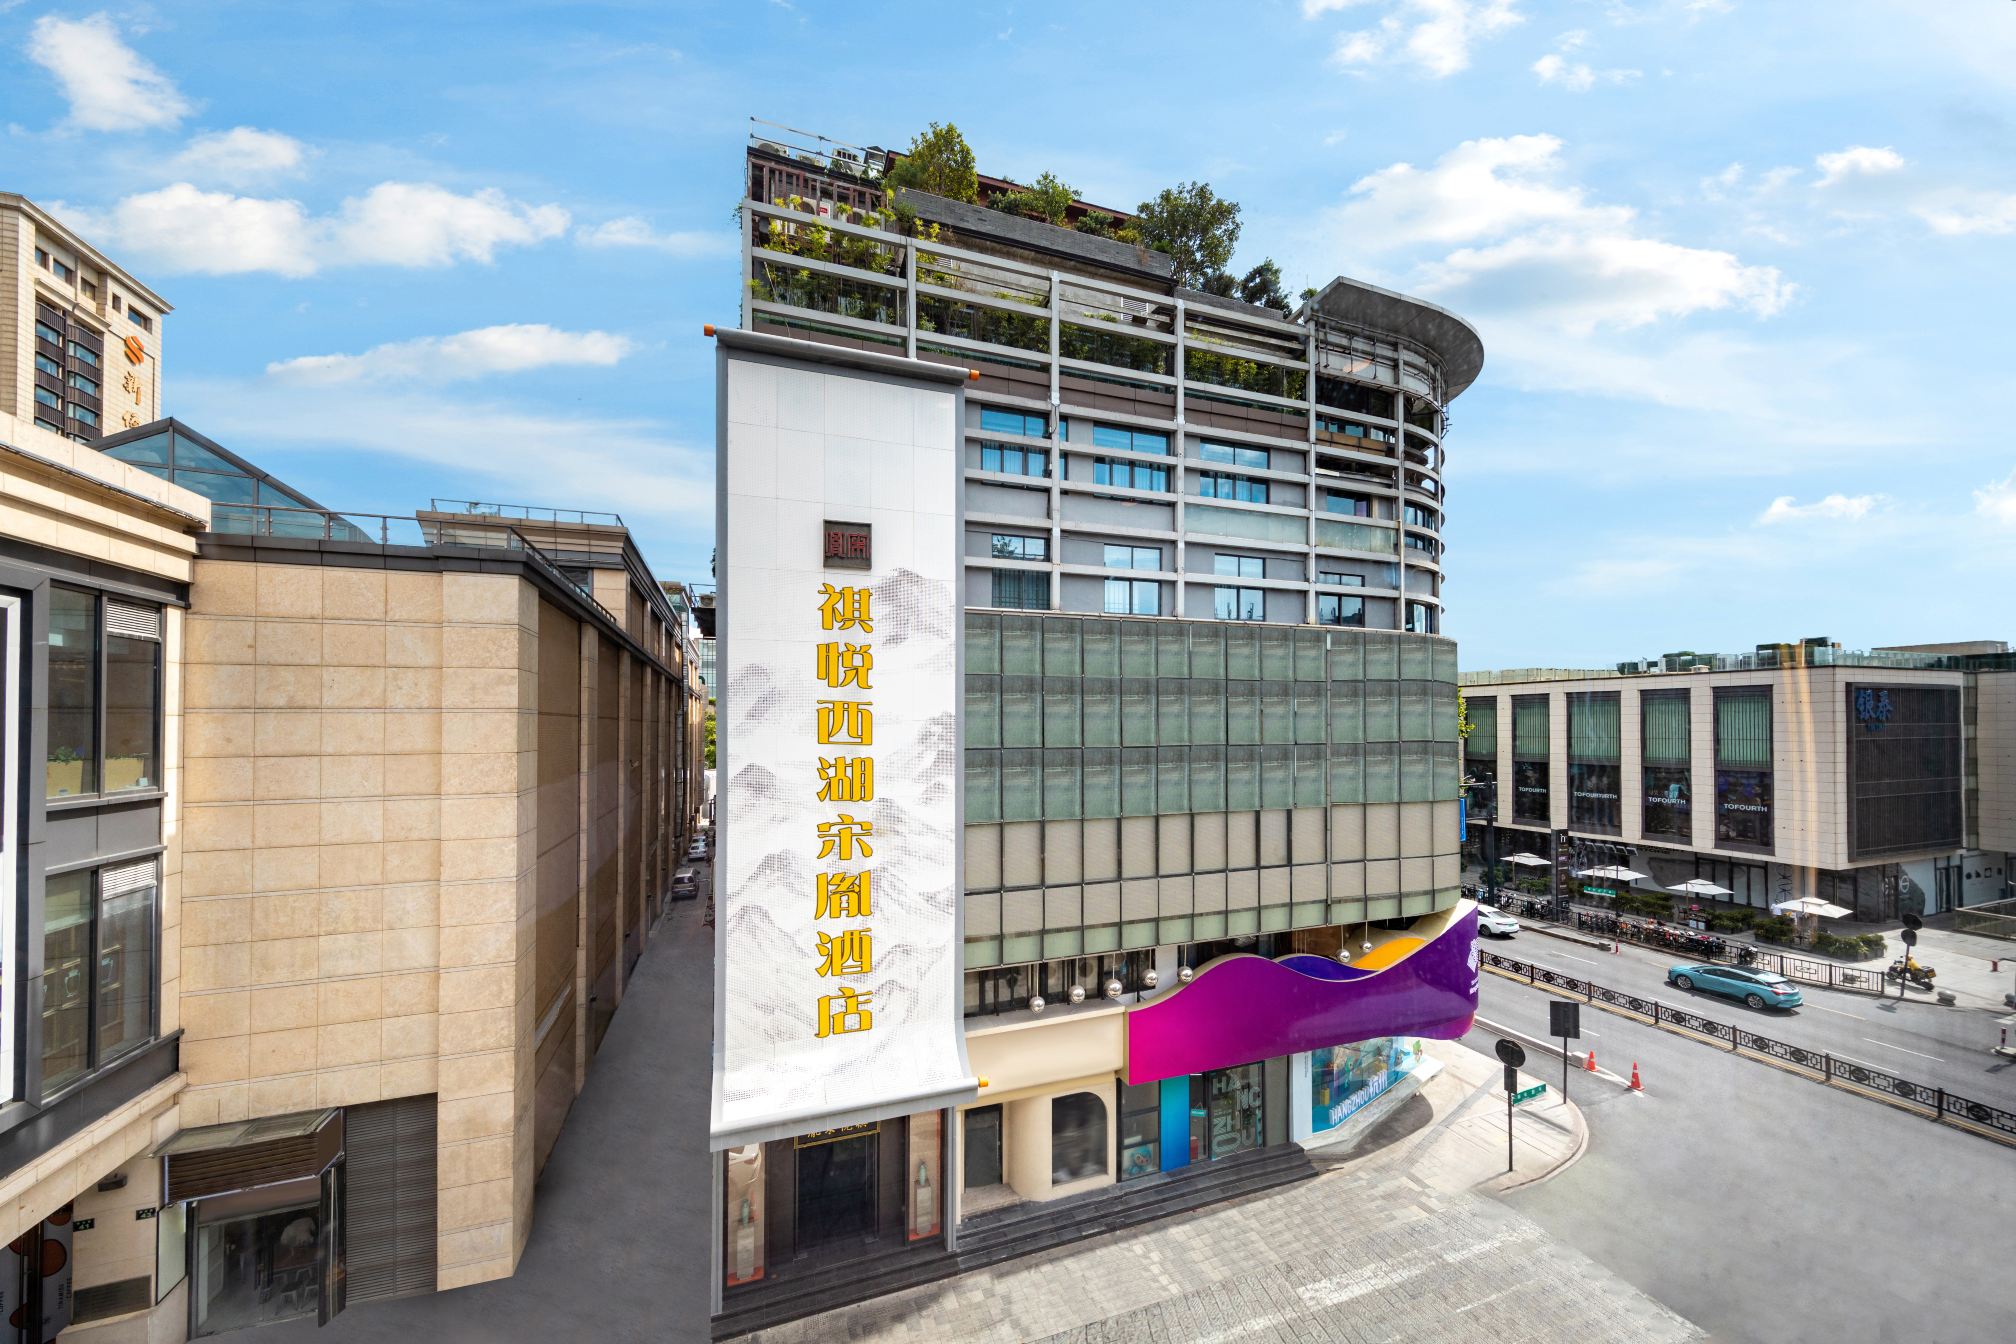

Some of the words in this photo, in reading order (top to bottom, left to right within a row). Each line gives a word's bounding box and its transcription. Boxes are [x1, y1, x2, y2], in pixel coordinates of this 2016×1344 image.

[815, 582, 874, 1038] 祺悦西湖宋胤酒店
[1648, 797, 1686, 805] TOFOURTH
[1724, 803, 1768, 812] TOFOURTH
[1329, 1088, 1370, 1125] HANGZHOU
[1368, 1069, 1388, 1098] 杭州
